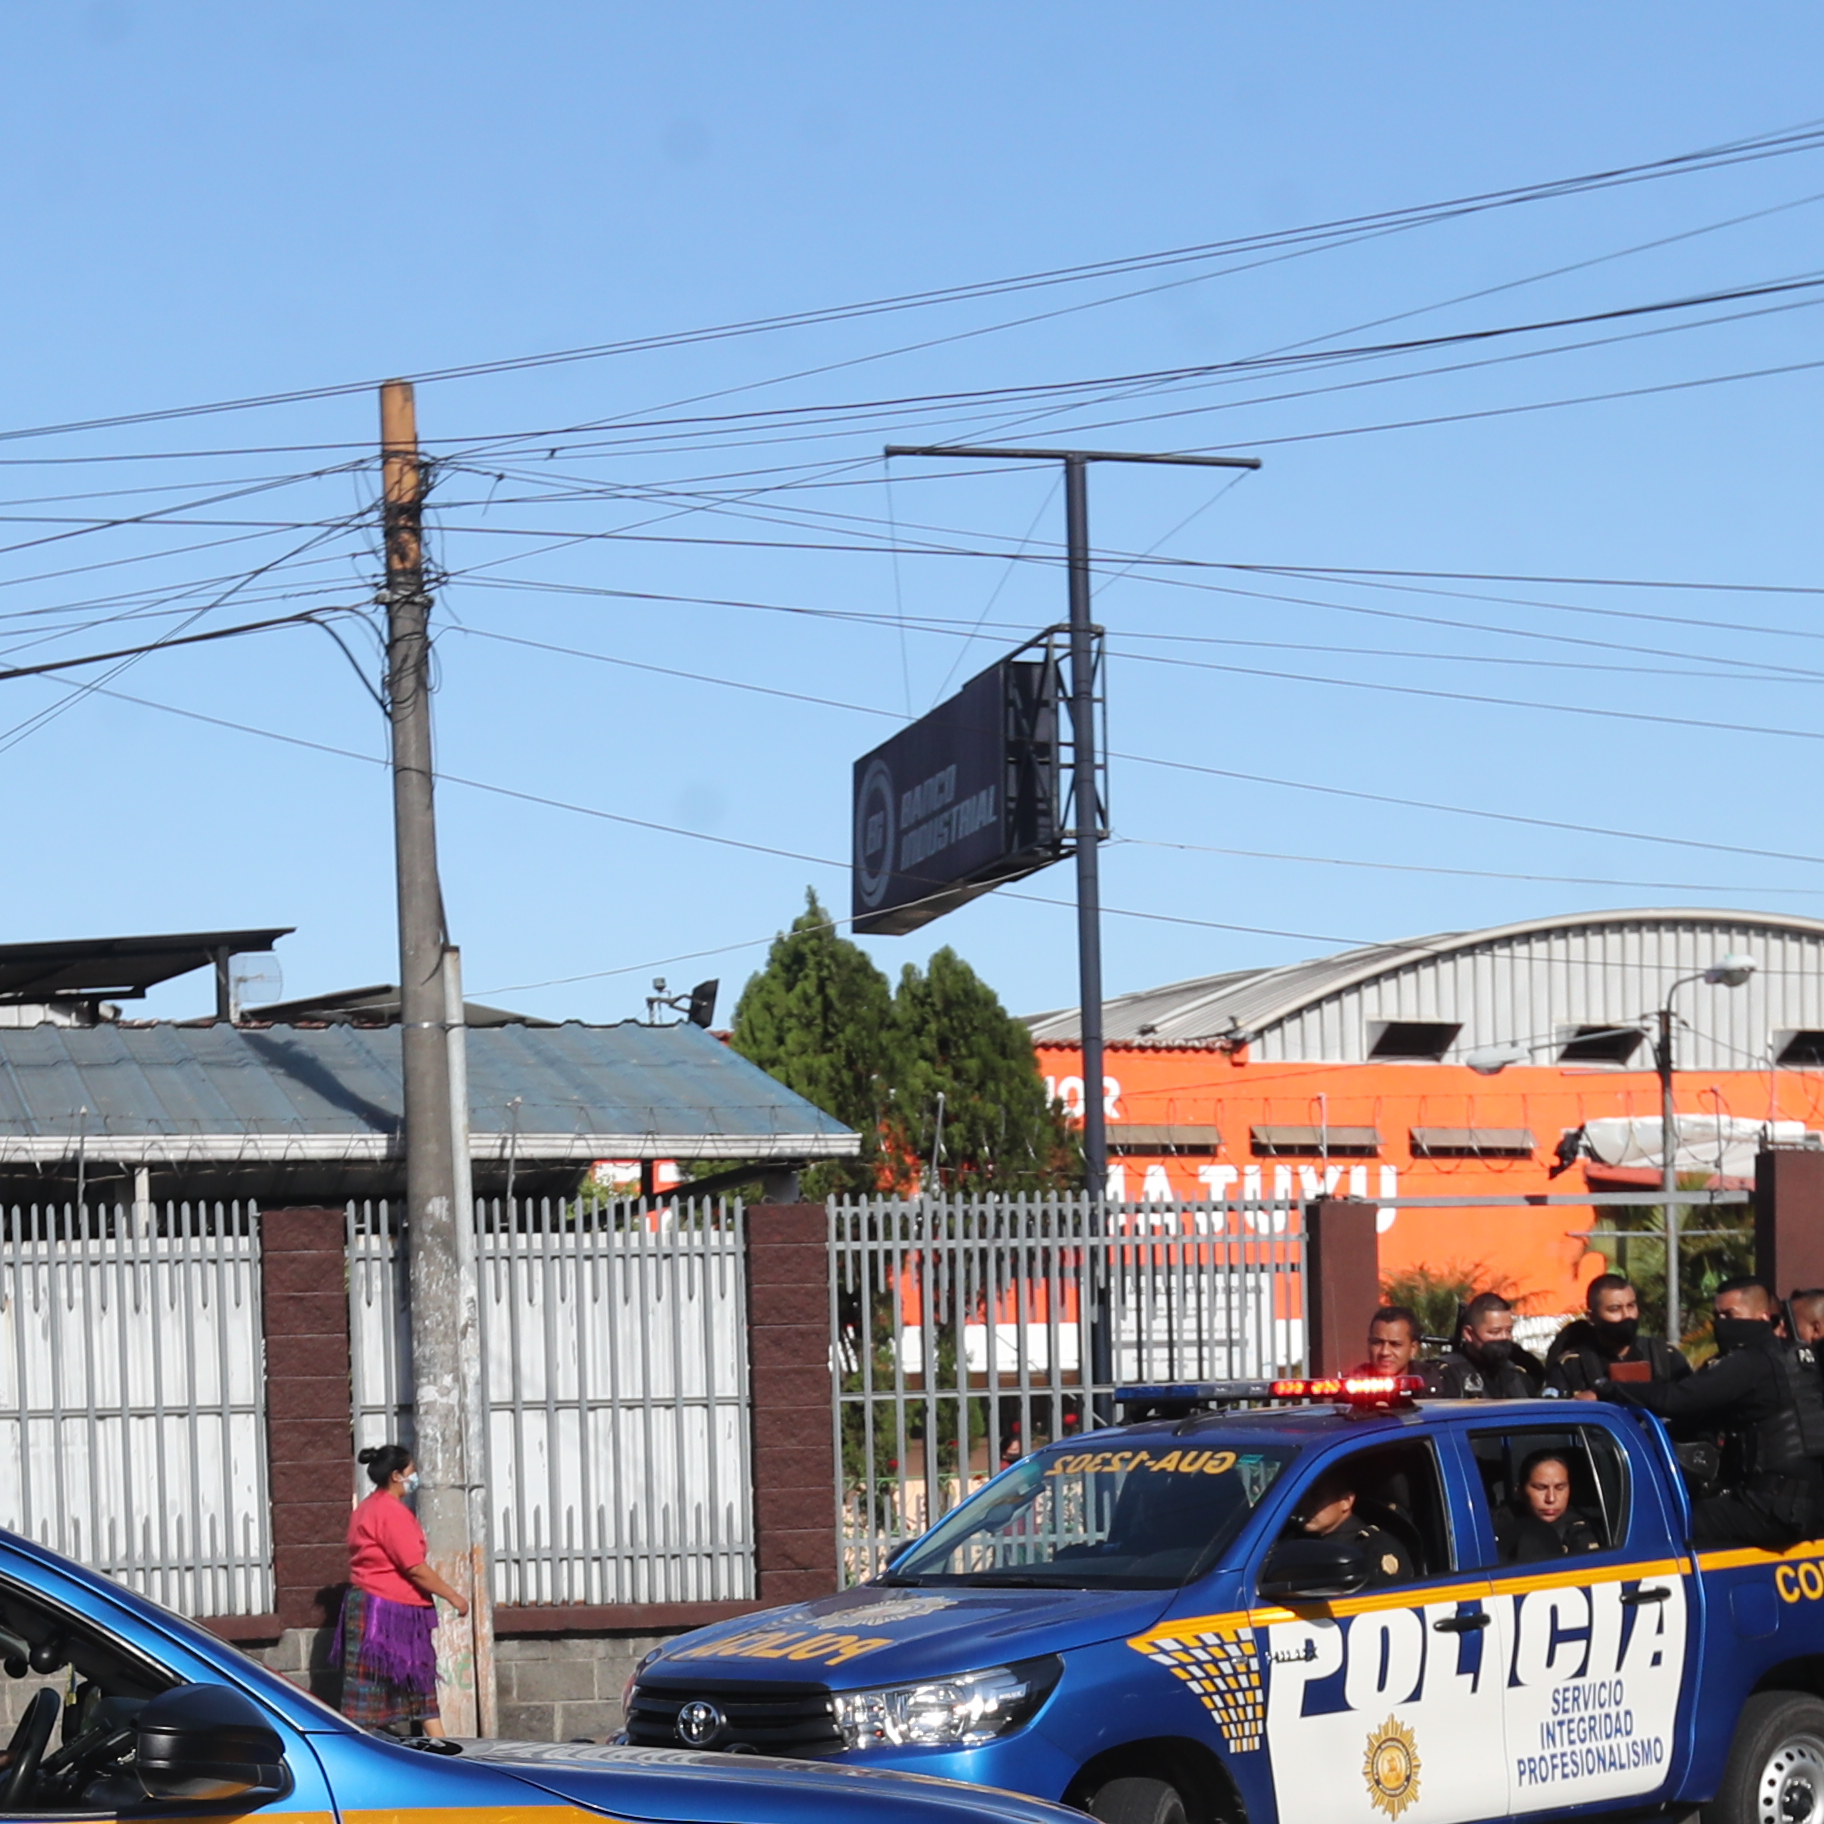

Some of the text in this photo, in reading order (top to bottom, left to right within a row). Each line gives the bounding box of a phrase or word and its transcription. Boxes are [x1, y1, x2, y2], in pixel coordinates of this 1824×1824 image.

[1264, 1576, 1681, 1718] POLICIA
[1551, 1678, 1625, 1716] SERVICIO
[1540, 1709, 1634, 1751] INTEGRIDAD
[1516, 1735, 1665, 1788] PROFESIONALISMO
